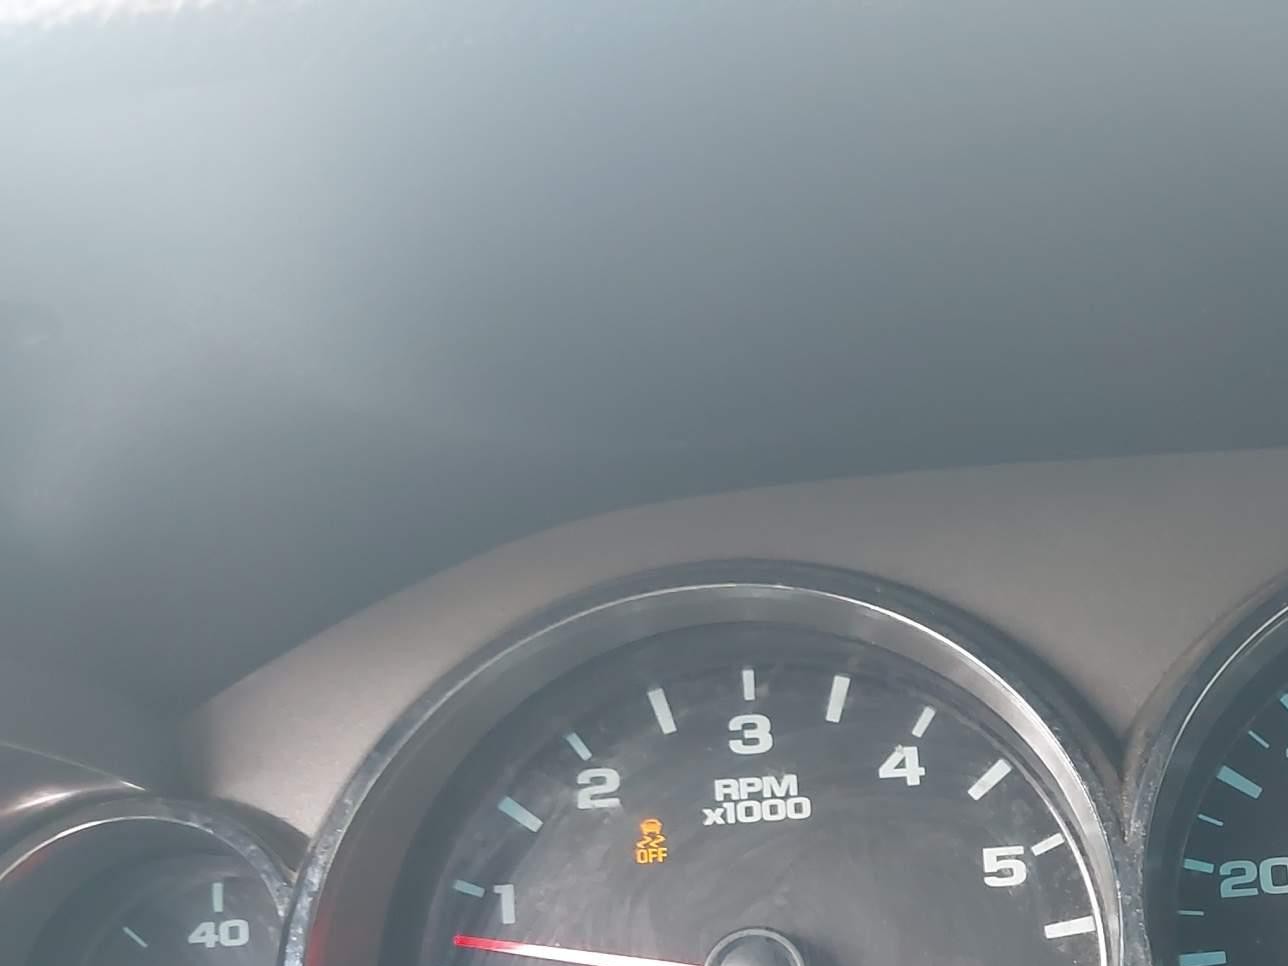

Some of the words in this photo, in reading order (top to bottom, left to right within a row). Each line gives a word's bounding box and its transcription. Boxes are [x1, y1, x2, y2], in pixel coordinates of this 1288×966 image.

[728, 715, 773, 755] 3
[878, 746, 924, 786] 4
[576, 768, 621, 810] 2
[714, 775, 798, 802] RPM
[702, 797, 812, 825] x1000
[636, 848, 668, 864] OFF
[983, 846, 1027, 888] 5
[494, 884, 516, 924] 1
[188, 919, 249, 948] 40
